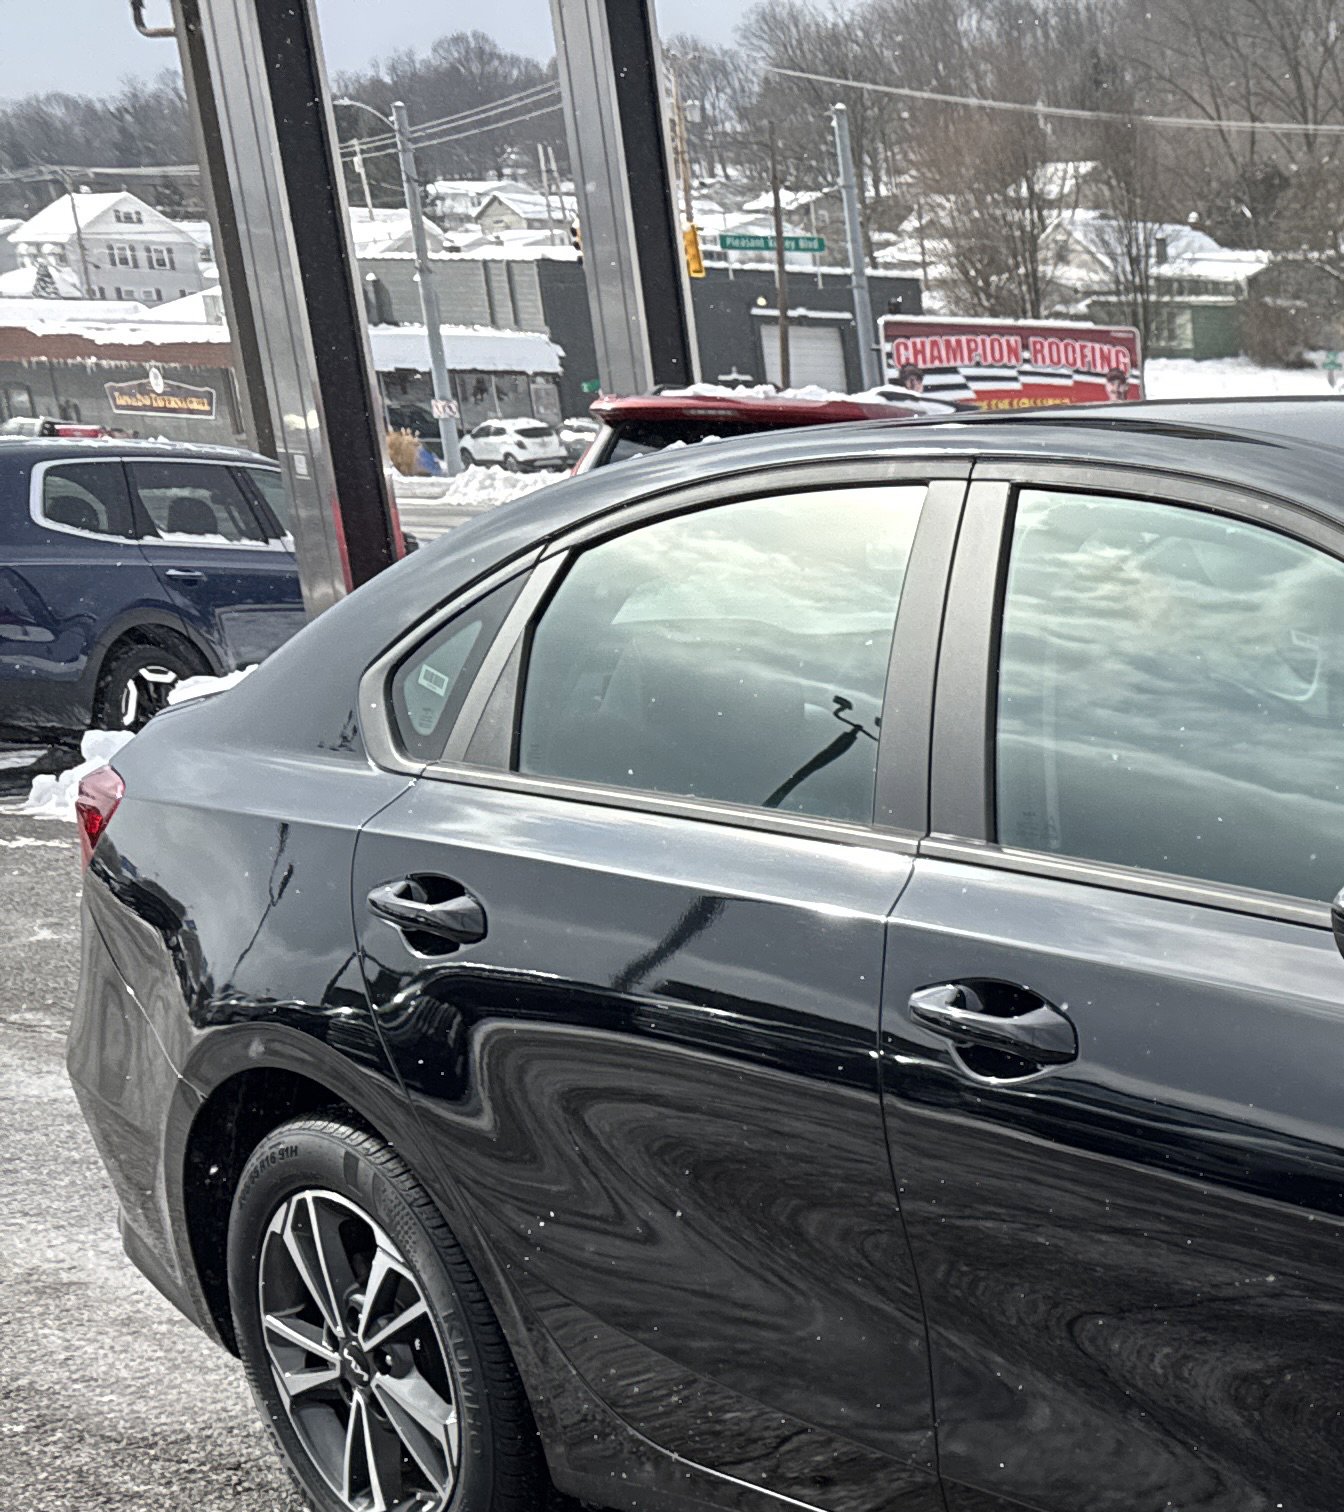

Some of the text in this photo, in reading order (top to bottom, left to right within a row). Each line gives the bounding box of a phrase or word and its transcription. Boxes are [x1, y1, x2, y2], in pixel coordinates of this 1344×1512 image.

[725, 236, 765, 248] Pleasant
[892, 334, 1132, 374] CHAMPION ROOFING
